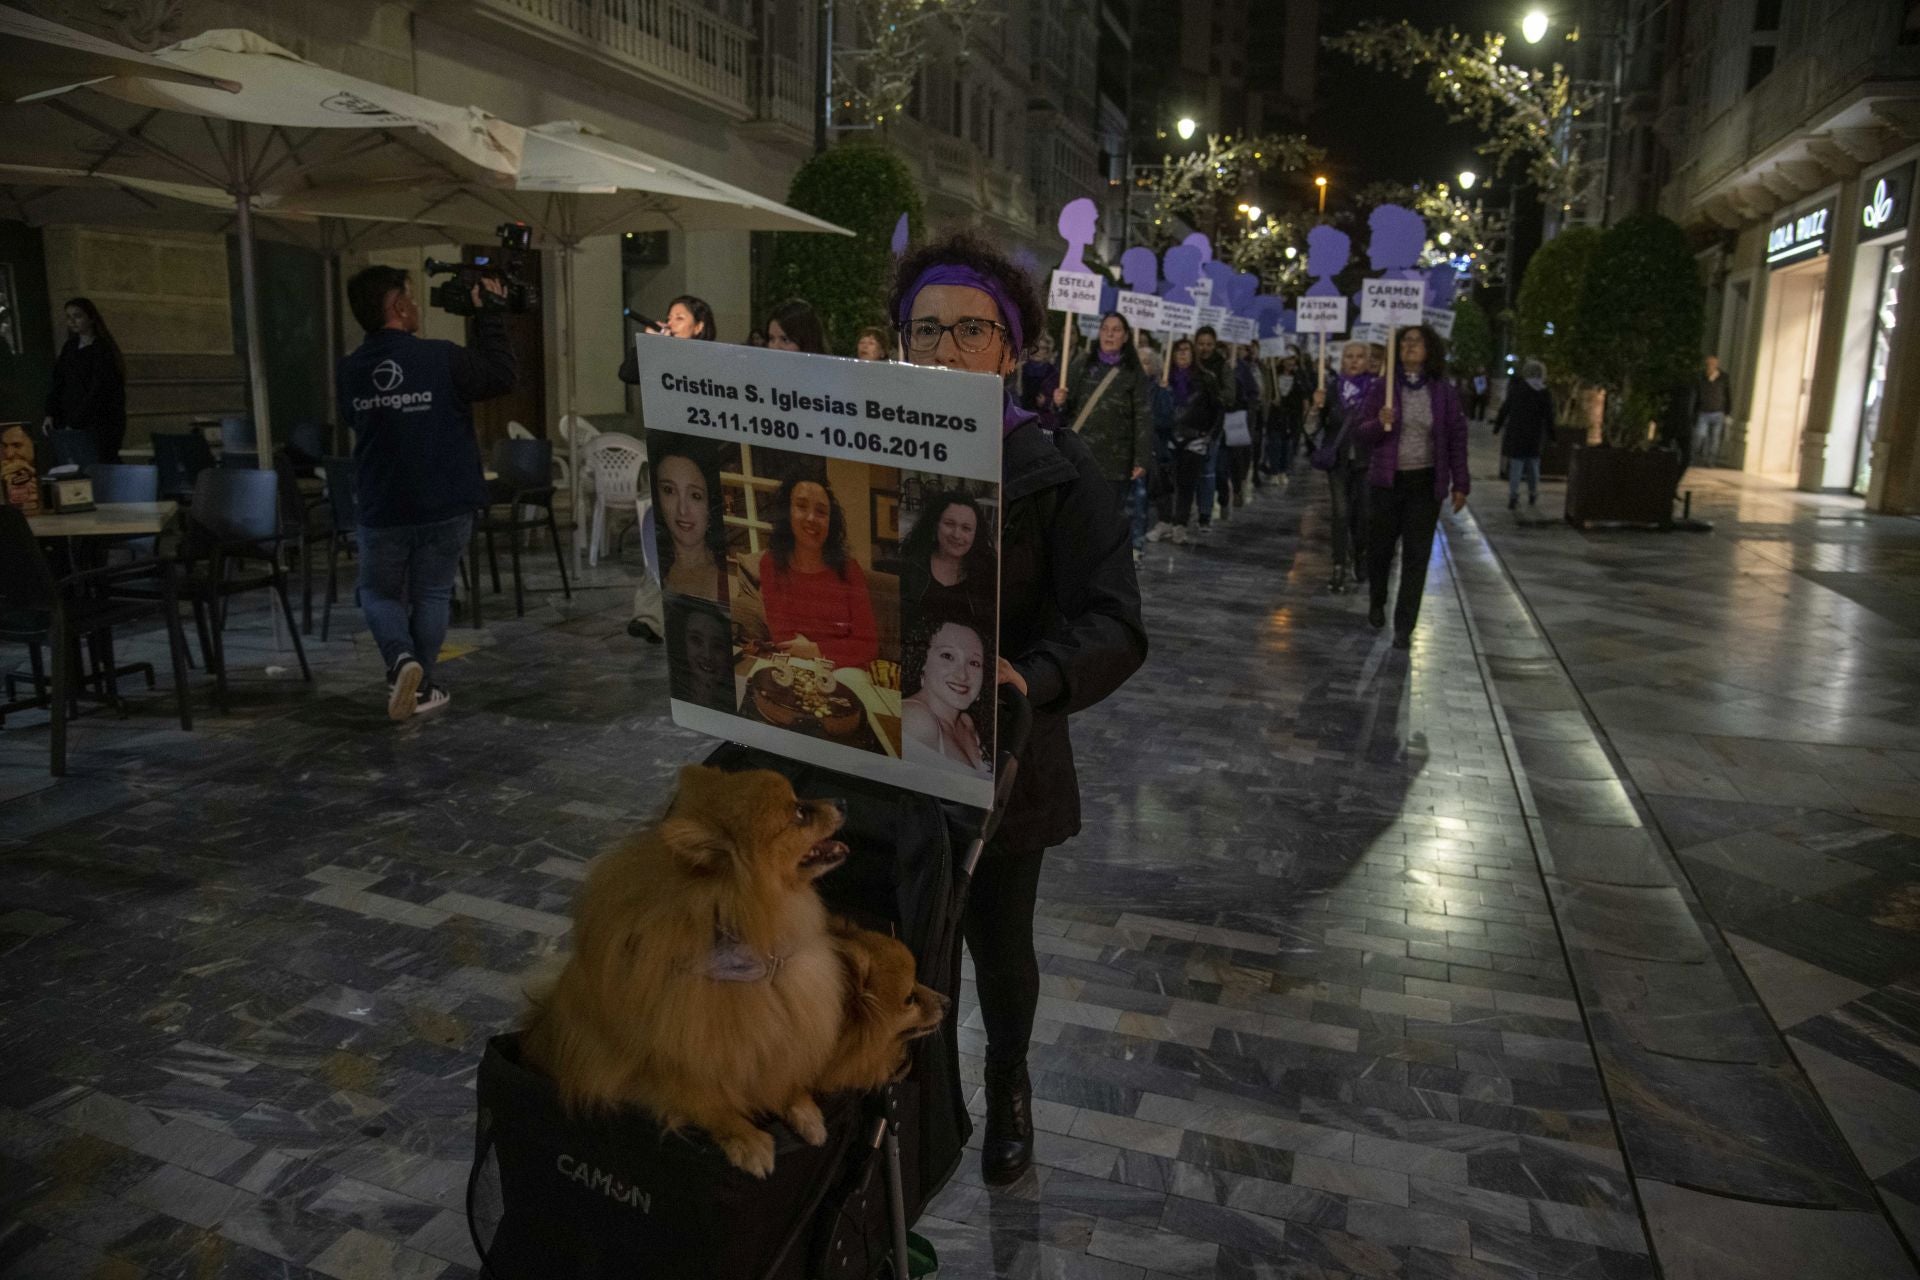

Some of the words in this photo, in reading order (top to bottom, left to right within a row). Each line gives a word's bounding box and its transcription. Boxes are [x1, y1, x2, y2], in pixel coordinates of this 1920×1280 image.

[1796, 208, 1828, 242] RUIZ
[1058, 276, 1095, 289] ESTELA
[1057, 288, 1069, 298] 36
[1072, 291, 1096, 301] años
[1368, 285, 1419, 296] CARMEN
[1371, 299, 1386, 308] 74
[1390, 300, 1418, 310] años
[1314, 311, 1338, 321] años
[352, 391, 433, 411] Cartagena
[661, 372, 739, 400] Cristina
[744, 384, 764, 404] S.
[771, 387, 858, 416] Iglesias
[865, 400, 977, 433] Betanzos
[686, 407, 800, 440] 23.11.1980
[820, 427, 948, 462] 10.06.2016
